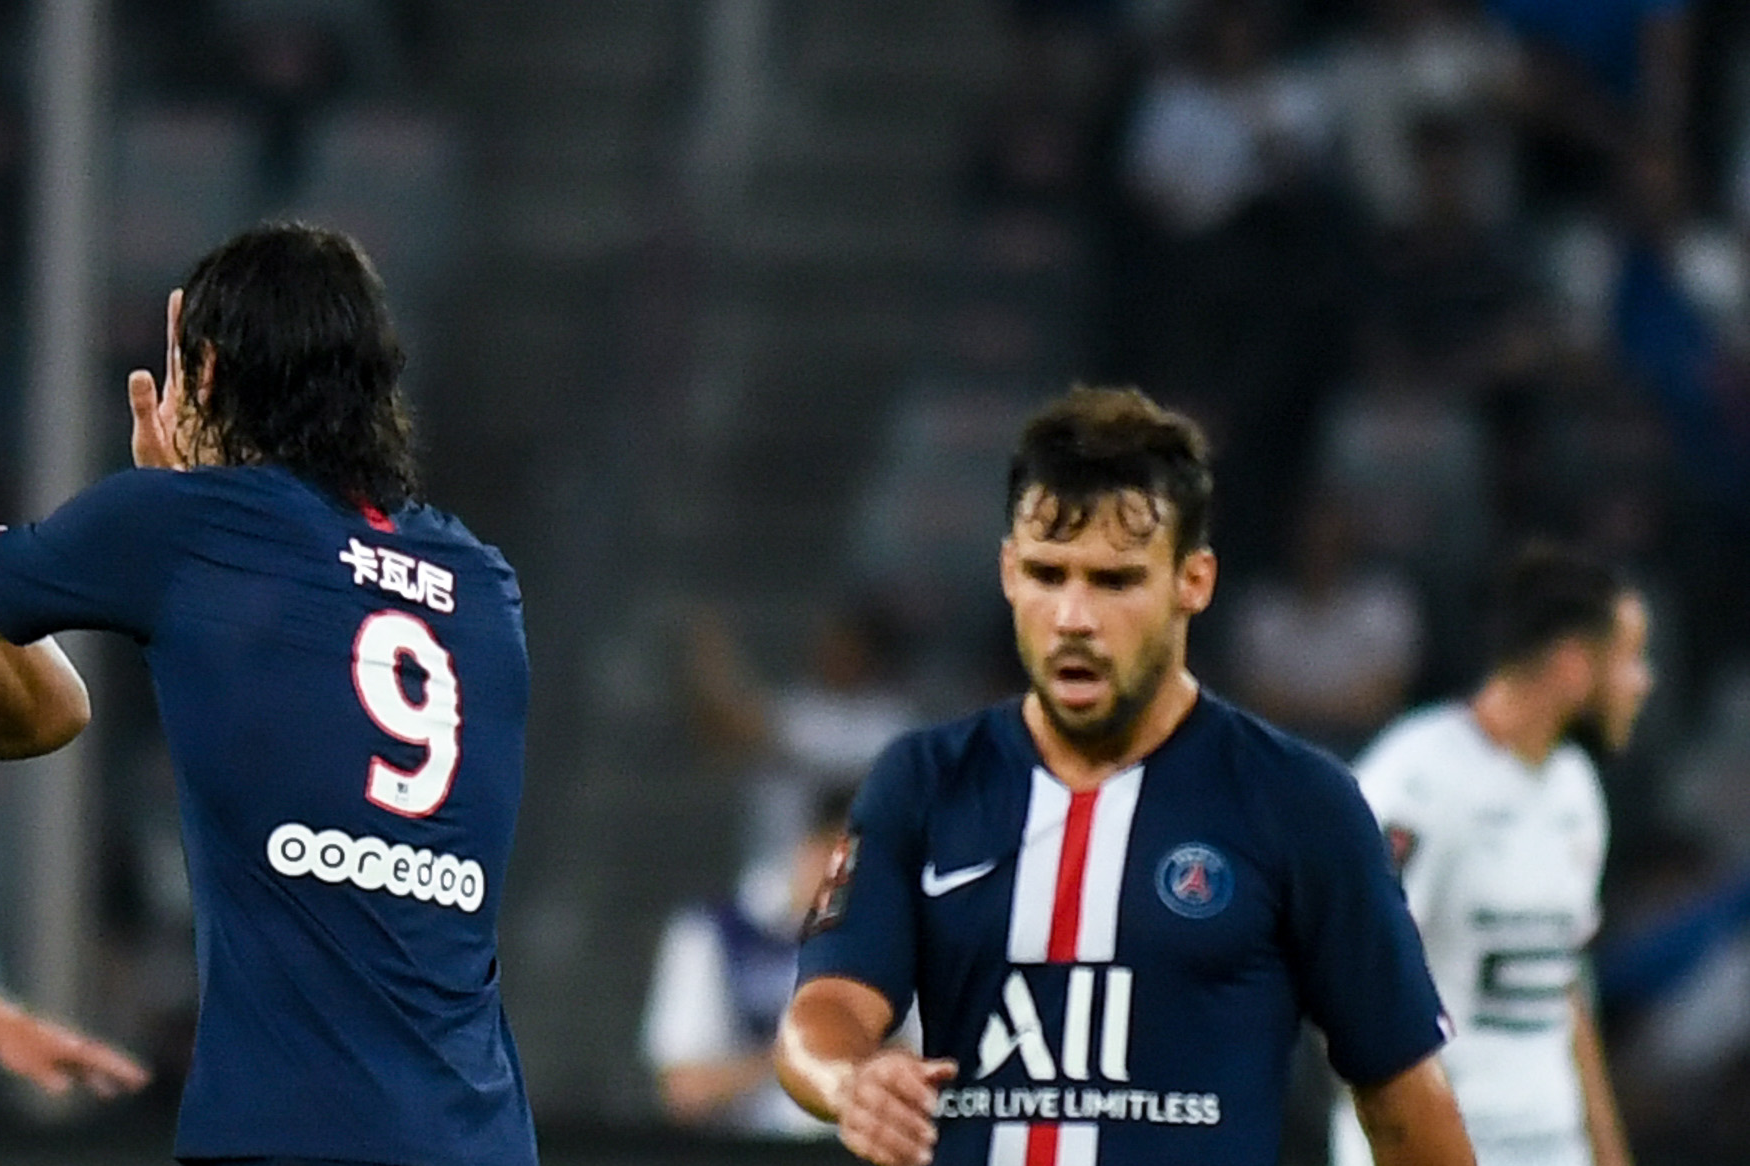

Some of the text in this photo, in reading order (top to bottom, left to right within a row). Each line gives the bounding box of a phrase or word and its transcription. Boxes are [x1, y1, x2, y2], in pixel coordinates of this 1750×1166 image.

[338, 537, 456, 613] 卡瓦尼
[352, 608, 462, 818] 9
[280, 837, 476, 898] ooredoo
[993, 1086, 1060, 1118] LIVE
[1062, 1086, 1221, 1125] LIMITLESS
